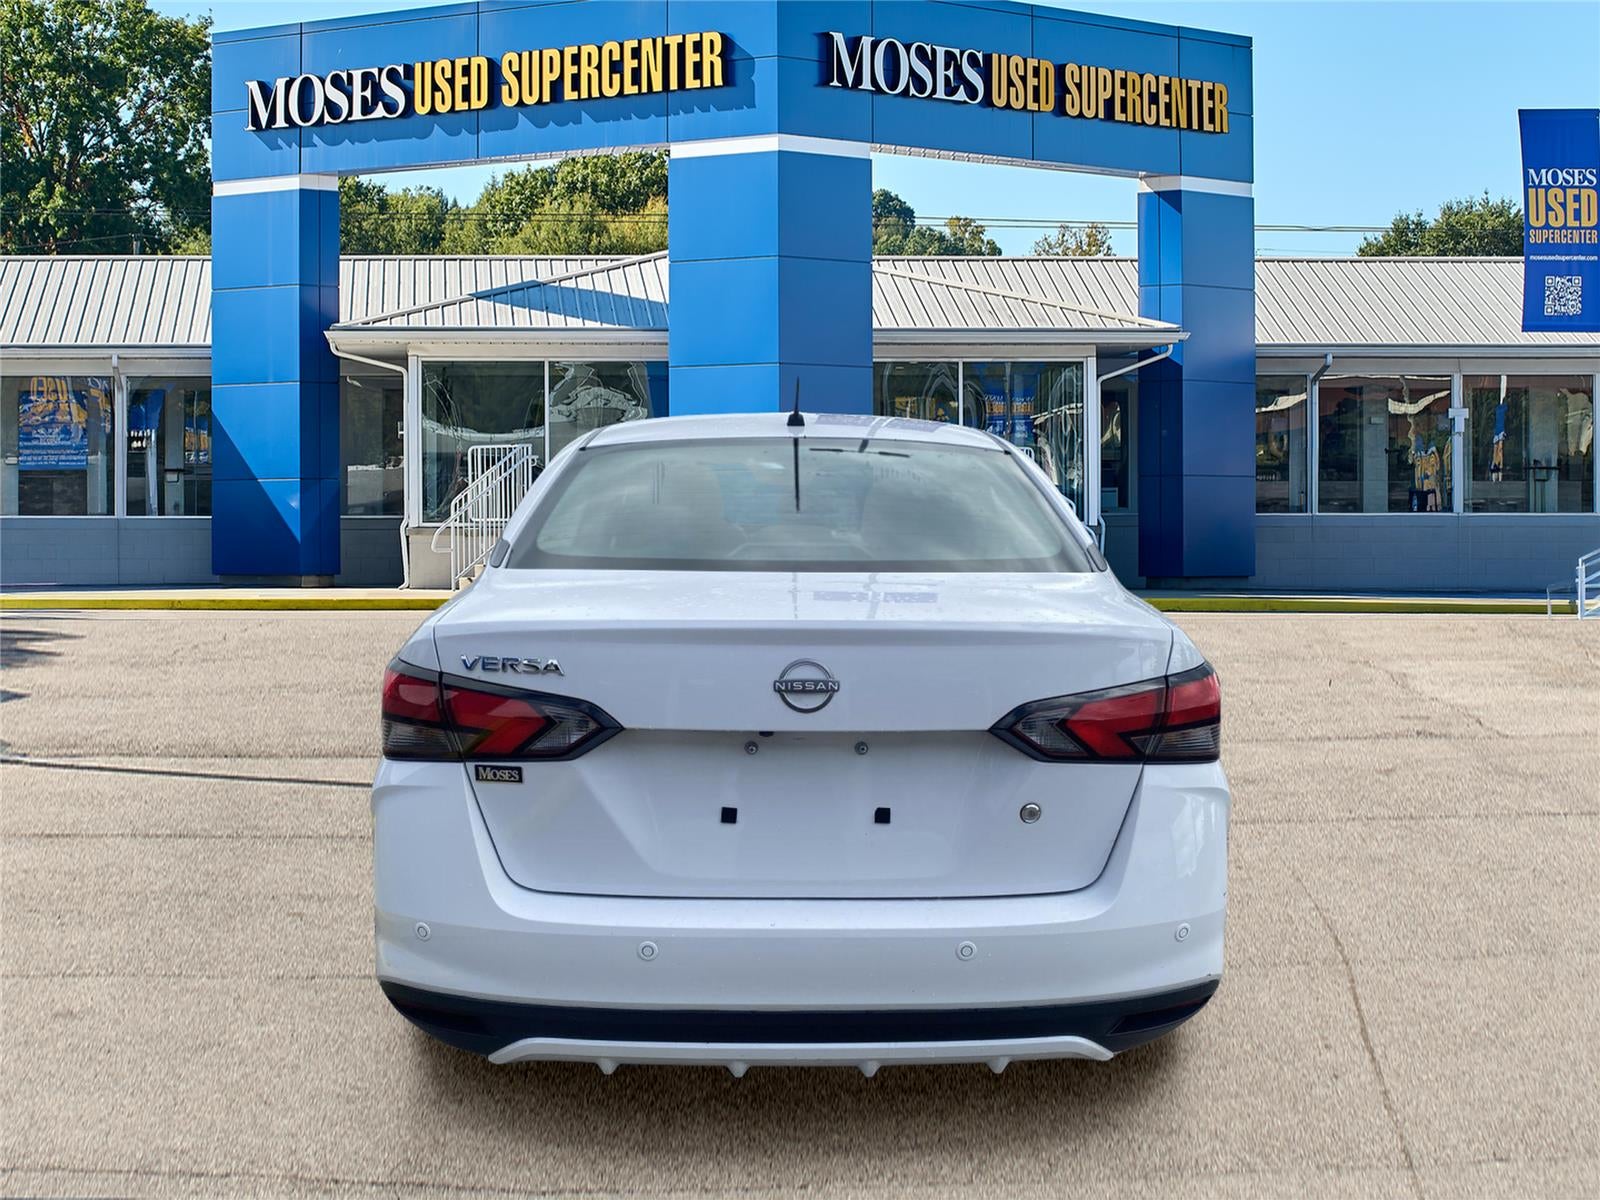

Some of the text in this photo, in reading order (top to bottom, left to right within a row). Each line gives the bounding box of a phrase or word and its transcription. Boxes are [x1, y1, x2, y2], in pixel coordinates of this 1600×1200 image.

[244, 31, 724, 132] MOSES USED SUPERCENTER
[828, 31, 1230, 133] MOSES USED SUPERCENTER
[1527, 168, 1597, 187] MOSES
[1528, 187, 1598, 228] USED
[1529, 229, 1598, 244] SUPERCENTER
[460, 654, 565, 676] VERSA
[775, 681, 839, 690] NISSAN
[478, 766, 519, 780] MOSES
